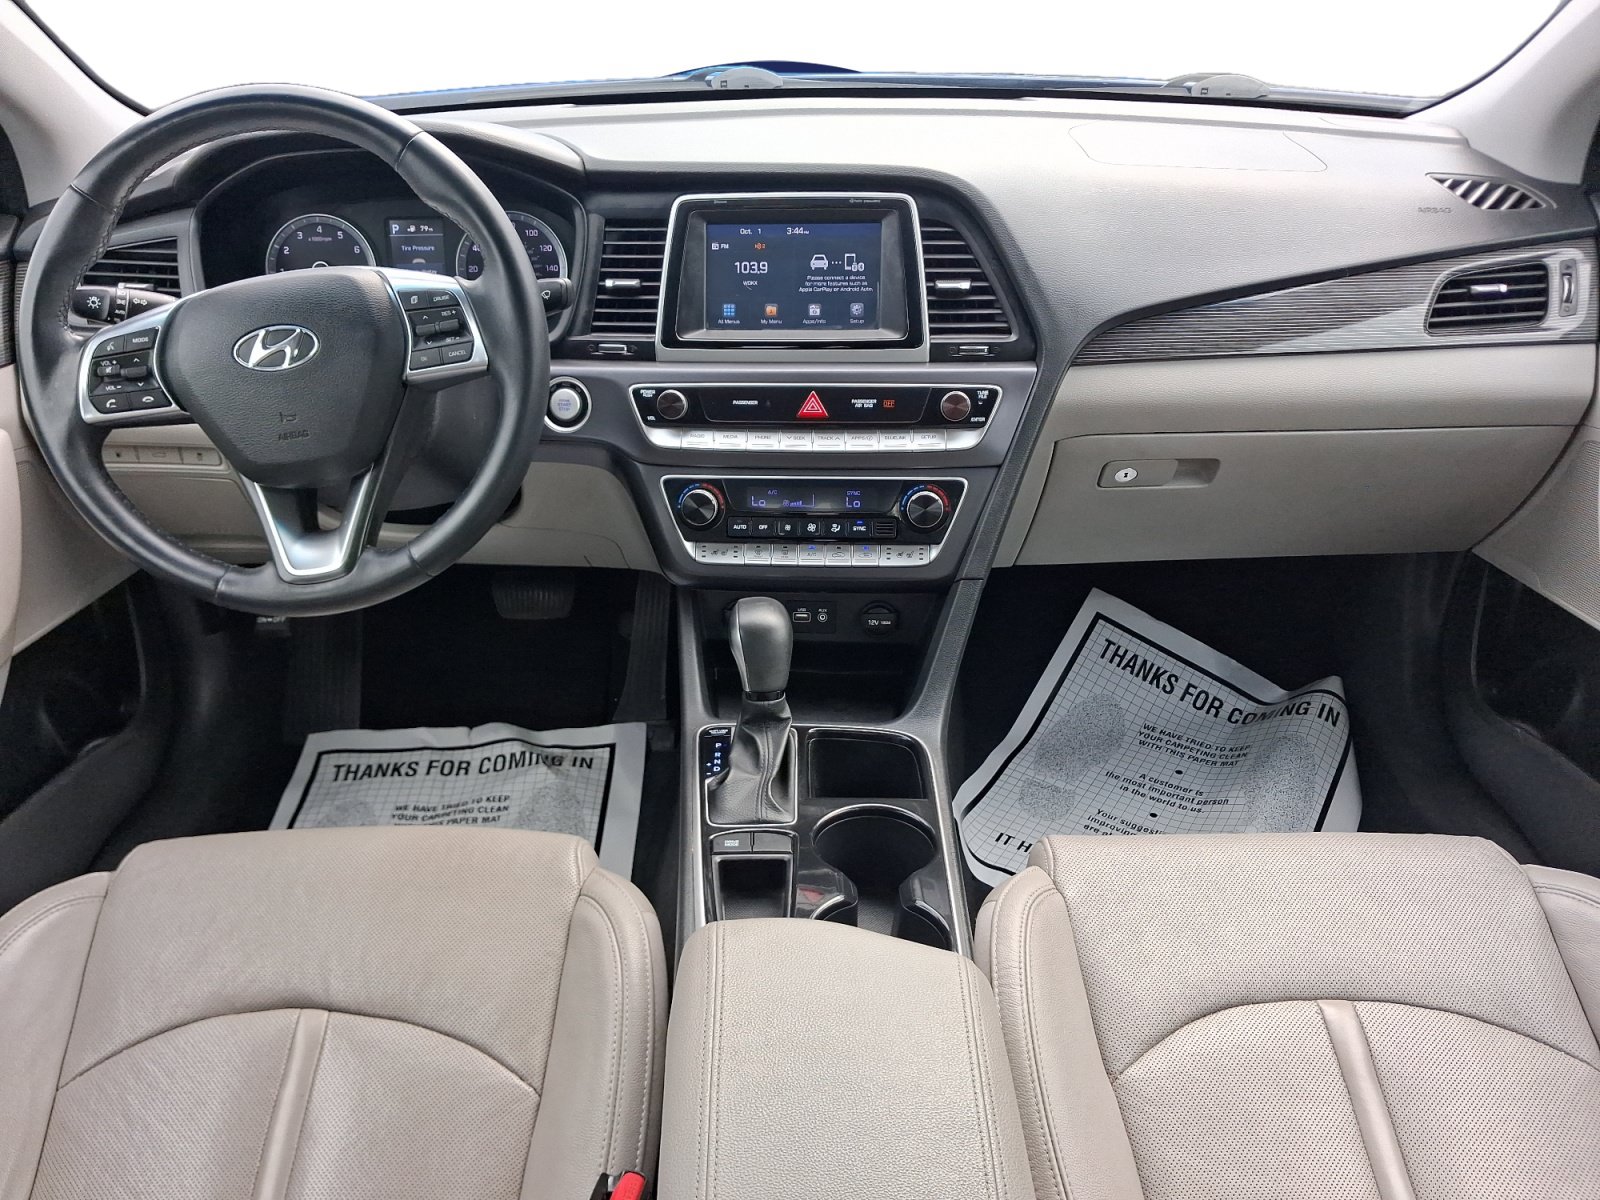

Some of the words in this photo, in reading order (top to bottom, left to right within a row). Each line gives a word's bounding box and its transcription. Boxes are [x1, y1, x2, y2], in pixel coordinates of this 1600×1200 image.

[297, 232, 302, 240] 3
[392, 224, 399, 234] P
[284, 246, 290, 254] 2
[354, 246, 360, 254] 6
[734, 262, 768, 274] 103.9
[1100, 638, 1179, 694] THANKS
[1180, 682, 1224, 718] FOR
[1227, 702, 1312, 724] COMING
[1317, 703, 1340, 728] IN
[1139, 731, 1162, 743] YOUR
[1165, 740, 1216, 758] CARPETING
[1143, 723, 1157, 732] WE
[1159, 728, 1183, 741] HAVE
[1185, 736, 1212, 750] TRIED
[1138, 740, 1162, 751] WITH
[1165, 747, 1186, 759] THIS
[1187, 754, 1218, 766] PAPER
[332, 761, 419, 782] THANKS
[426, 760, 470, 776] FOR
[478, 750, 564, 774] COMING
[572, 756, 594, 769] IN
[1105, 771, 1121, 780] the
[1122, 776, 1147, 789] most
[1148, 786, 1196, 805] important
[1196, 798, 1229, 806] person
[1148, 777, 1193, 794] customer
[442, 800, 468, 810] TRIED
[486, 795, 510, 803] KEEP
[1119, 784, 1129, 792] in
[1130, 788, 1146, 798] the
[1149, 795, 1176, 808] world
[392, 812, 418, 821] YOUR
[422, 807, 475, 822] CARPETING
[478, 805, 510, 814] CLEAN
[446, 816, 478, 825] PAPER
[481, 815, 501, 824] MAT
[1097, 808, 1118, 821] Your
[1084, 824, 1100, 834] are
[995, 832, 1015, 845] IT
[1016, 840, 1033, 852] H
